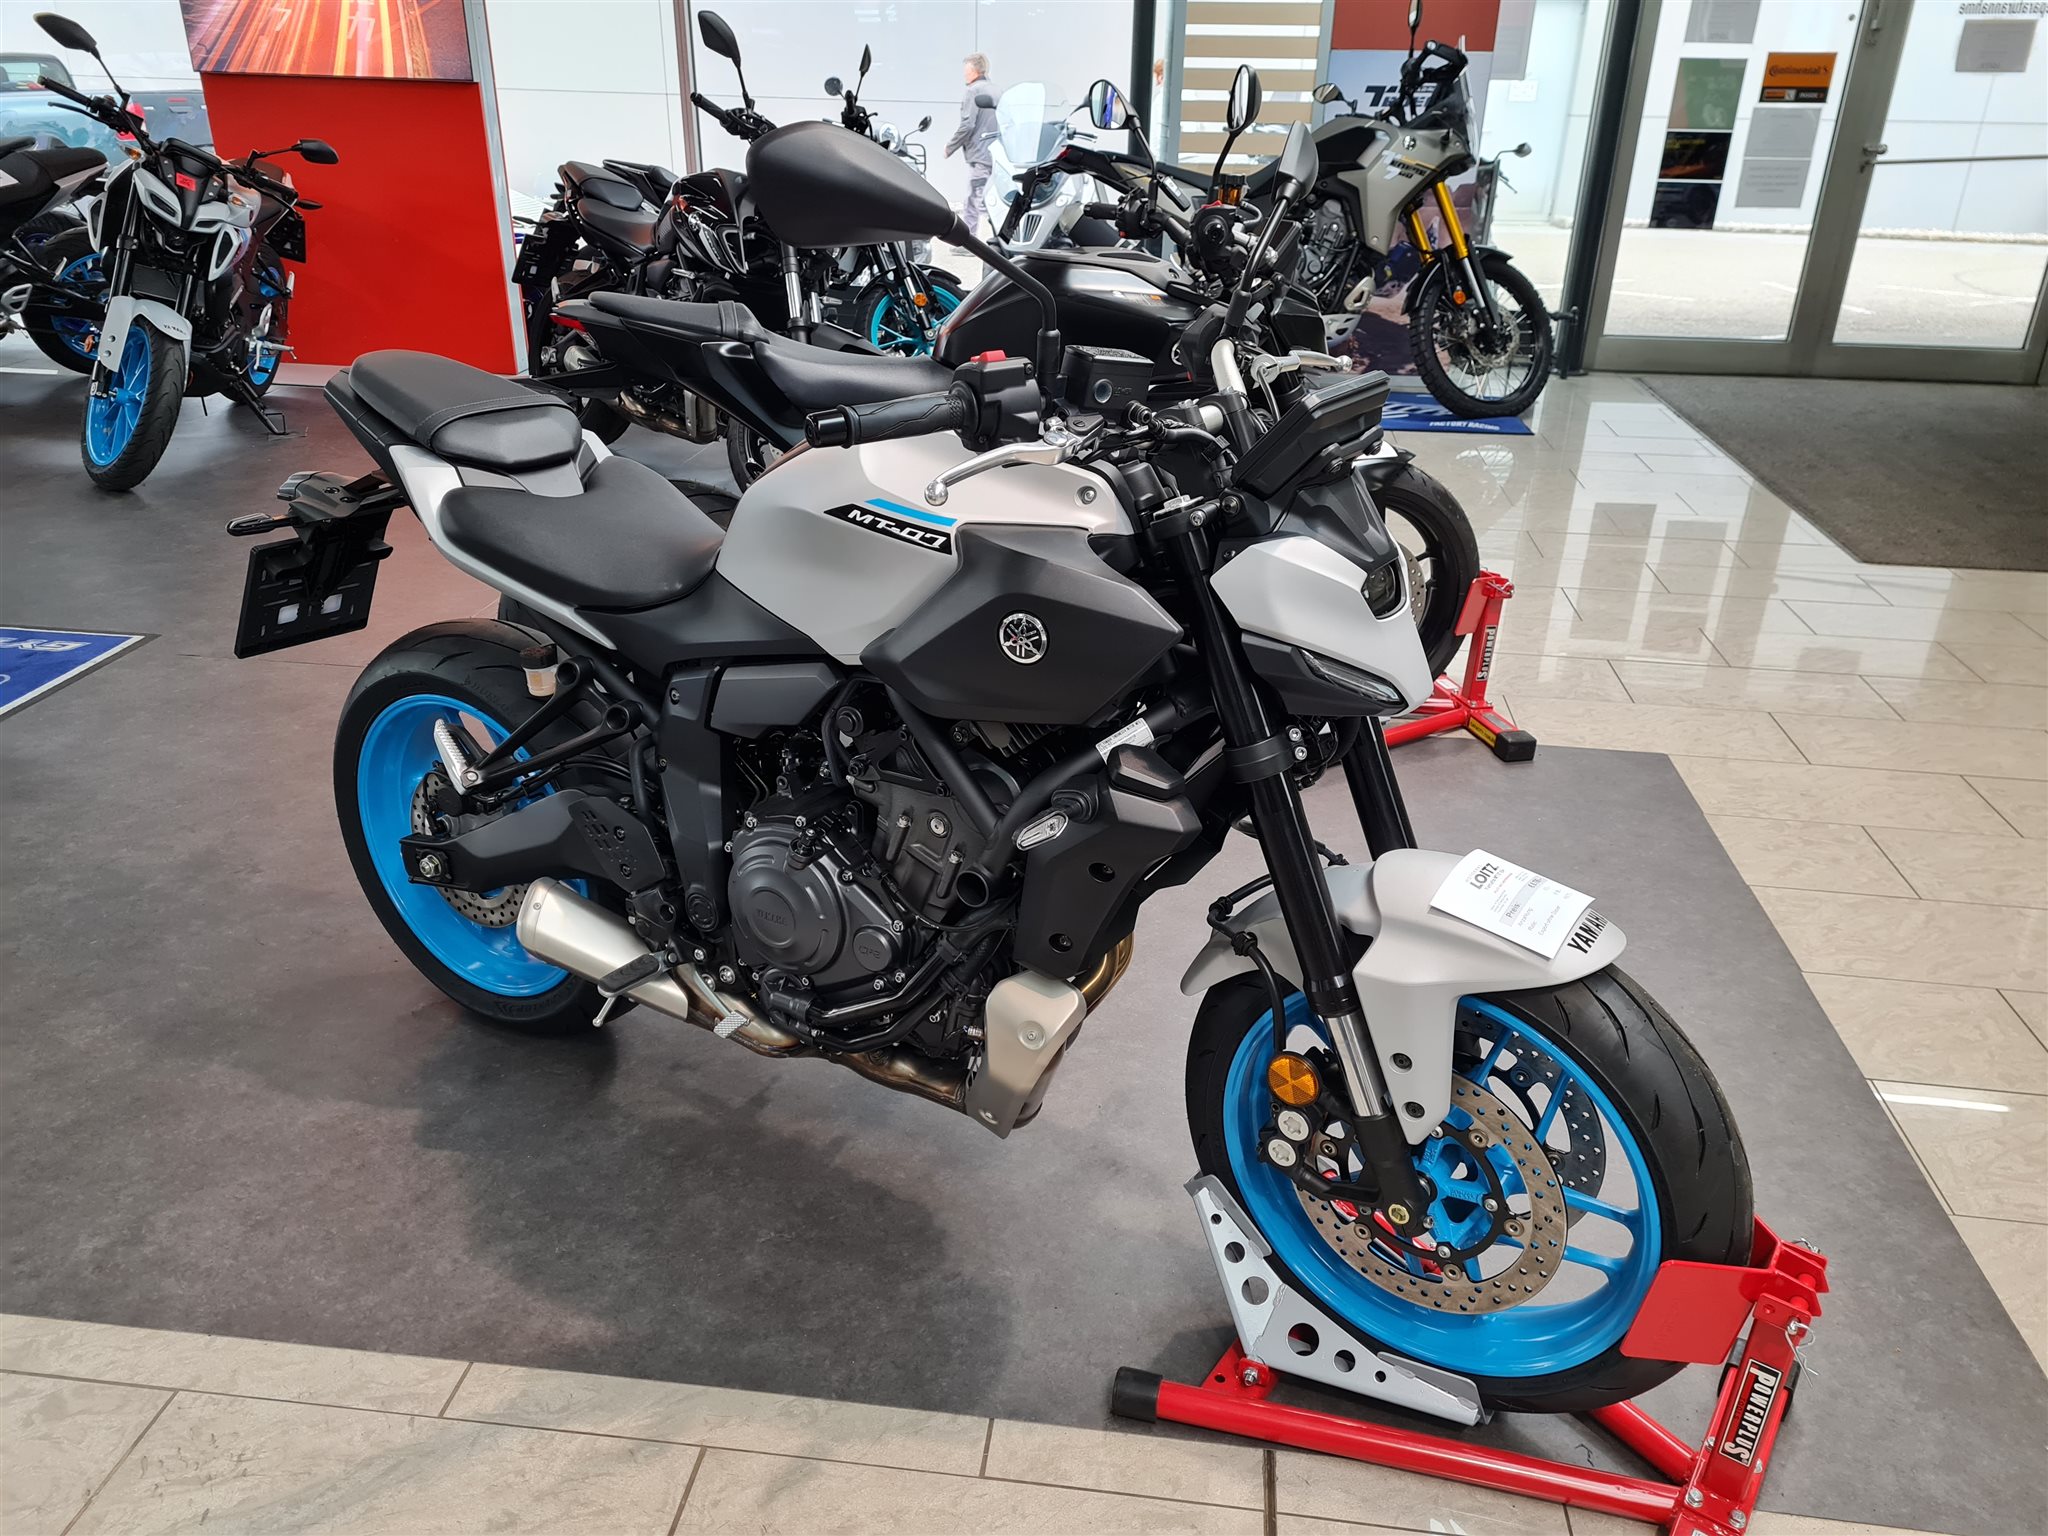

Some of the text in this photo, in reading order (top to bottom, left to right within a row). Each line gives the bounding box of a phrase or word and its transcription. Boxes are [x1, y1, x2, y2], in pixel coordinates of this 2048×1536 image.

[1768, 65, 1821, 77] Continental
[1429, 420, 1500, 431] FACTORY RACING
[847, 509, 947, 549] MT-07
[1470, 862, 1499, 890] LOITZ
[1505, 902, 1521, 918] Preis
[1723, 1366, 1777, 1463] POWERPLUS
